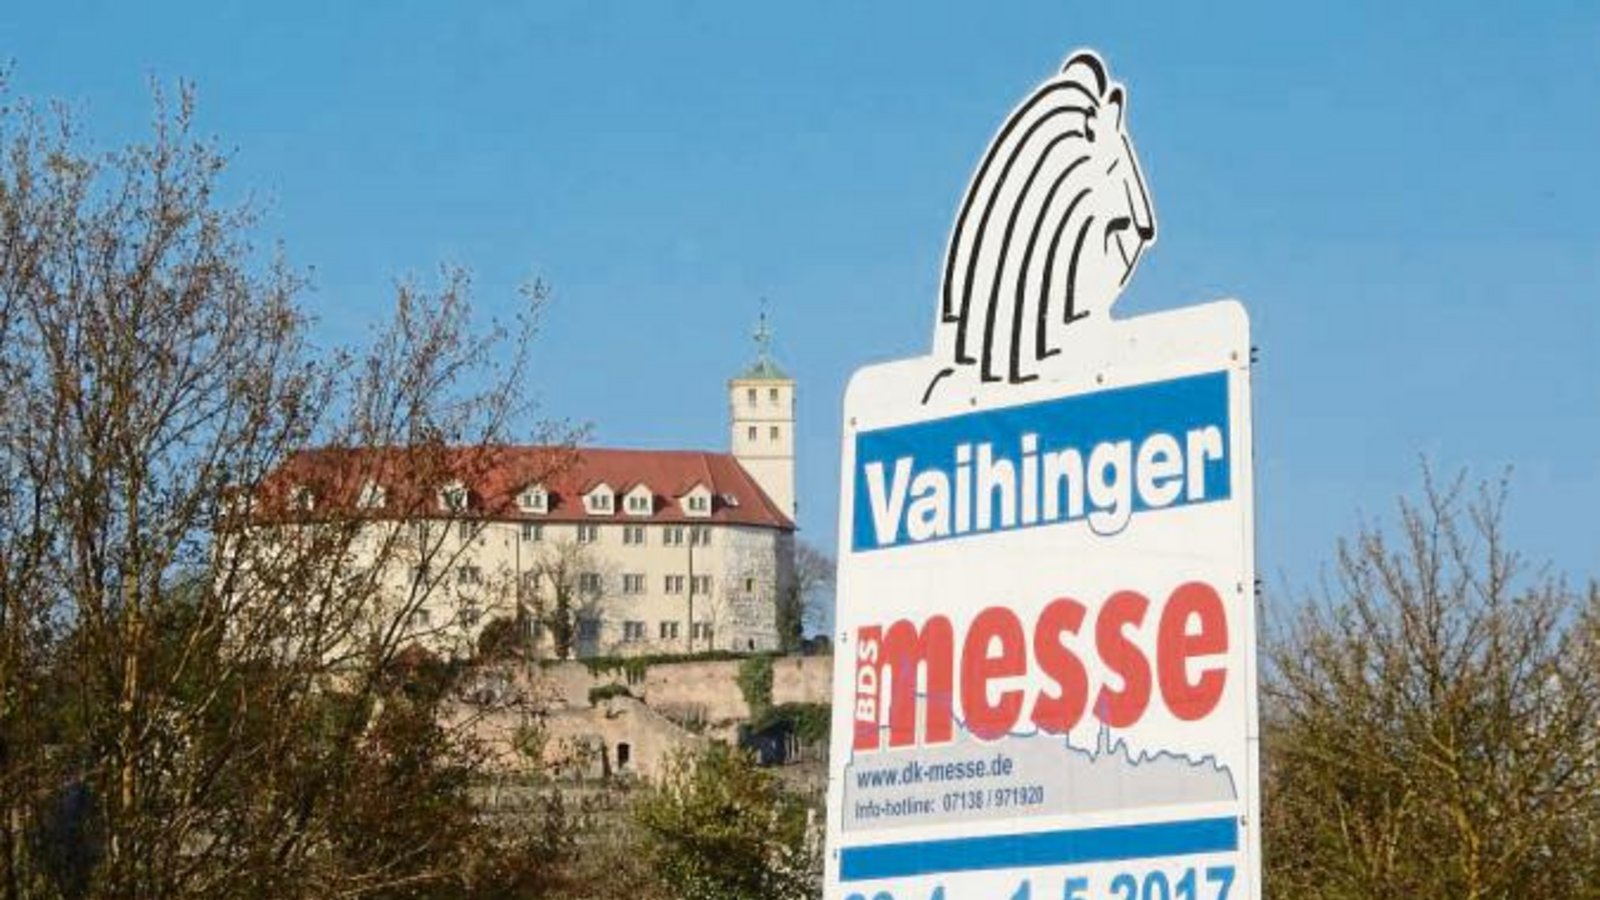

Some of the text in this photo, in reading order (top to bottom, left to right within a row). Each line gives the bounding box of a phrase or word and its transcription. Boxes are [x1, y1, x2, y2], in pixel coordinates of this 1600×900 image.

[865, 424, 1223, 544] Vaihinger
[853, 581, 1228, 750] messe
[856, 638, 878, 721] BDS
[857, 754, 1013, 788] www.dk-messe.de
